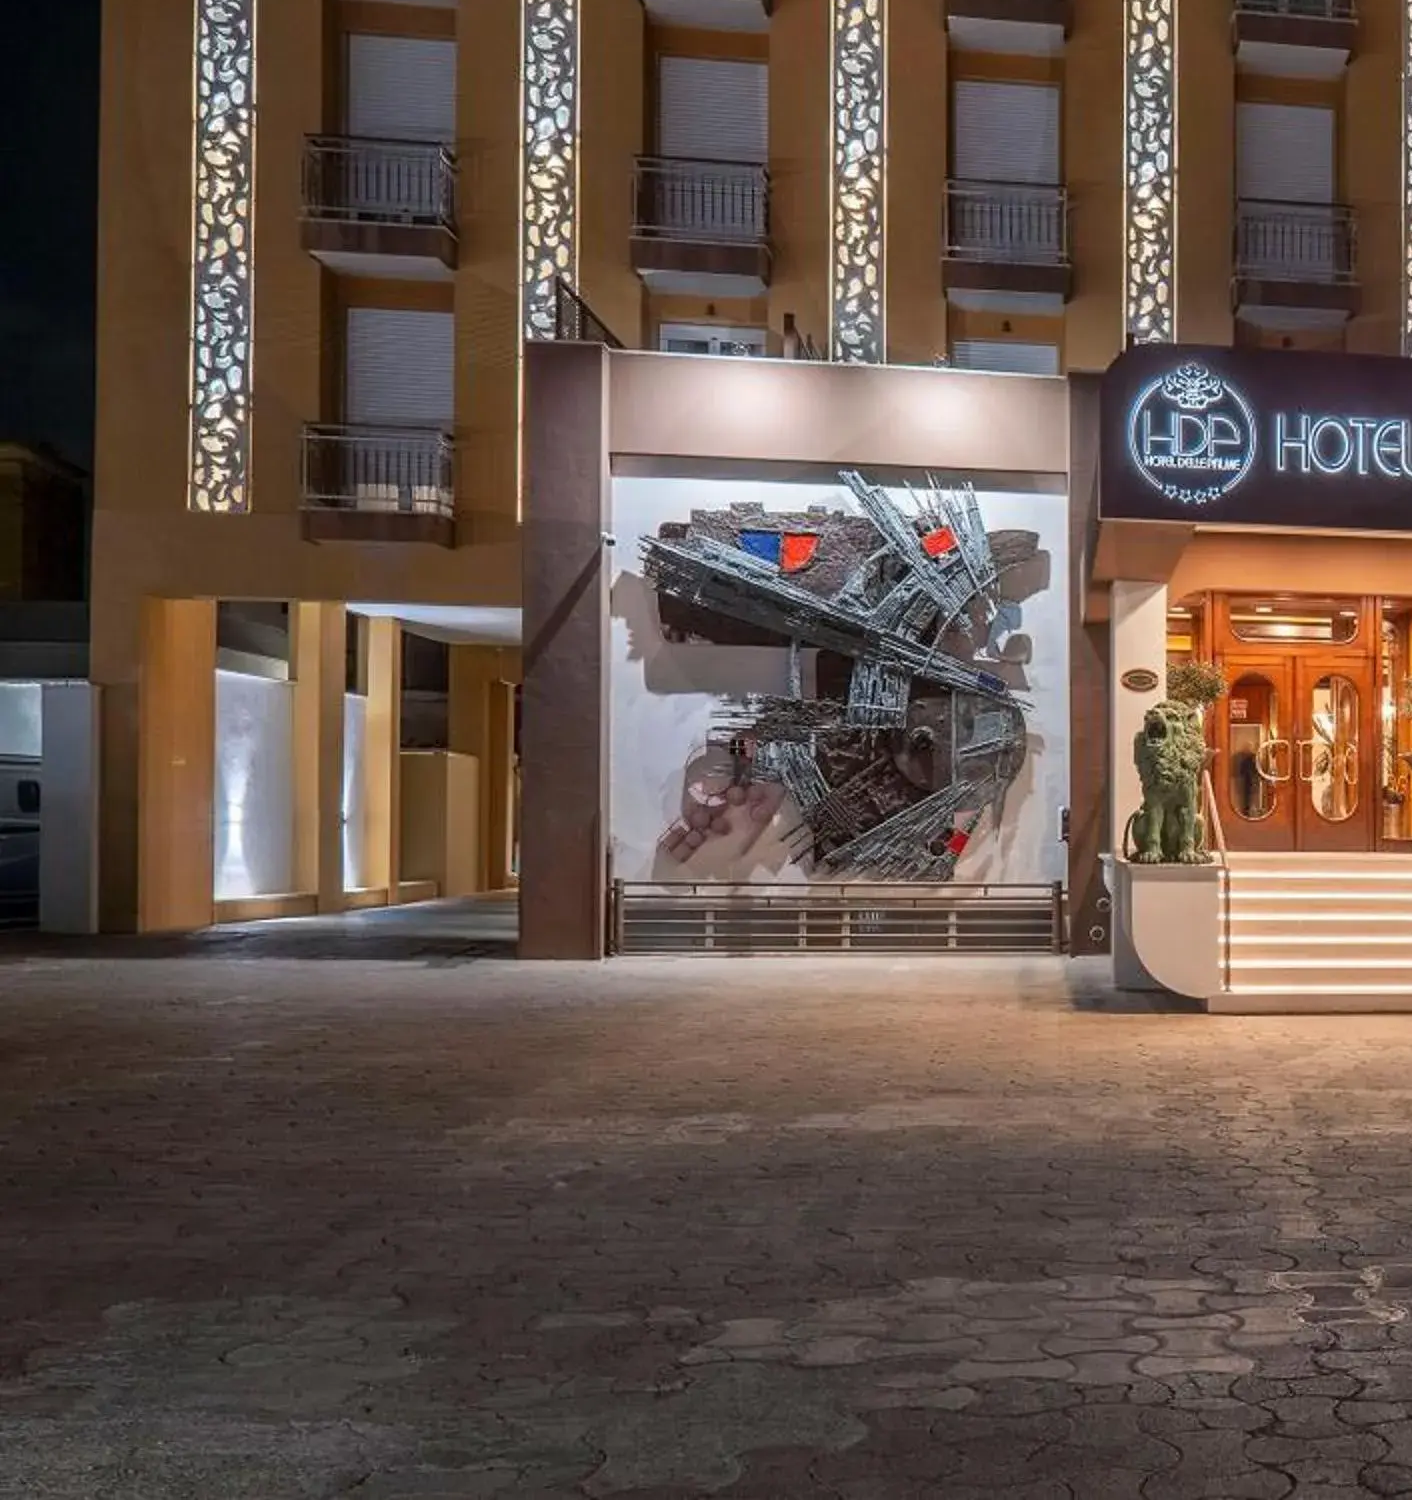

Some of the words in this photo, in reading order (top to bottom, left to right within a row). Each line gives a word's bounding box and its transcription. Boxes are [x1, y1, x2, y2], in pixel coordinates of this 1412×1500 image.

[1143, 410, 1241, 457] HDP
[1144, 455, 1176, 468] HOTEL
[1178, 456, 1207, 469] DELLE
